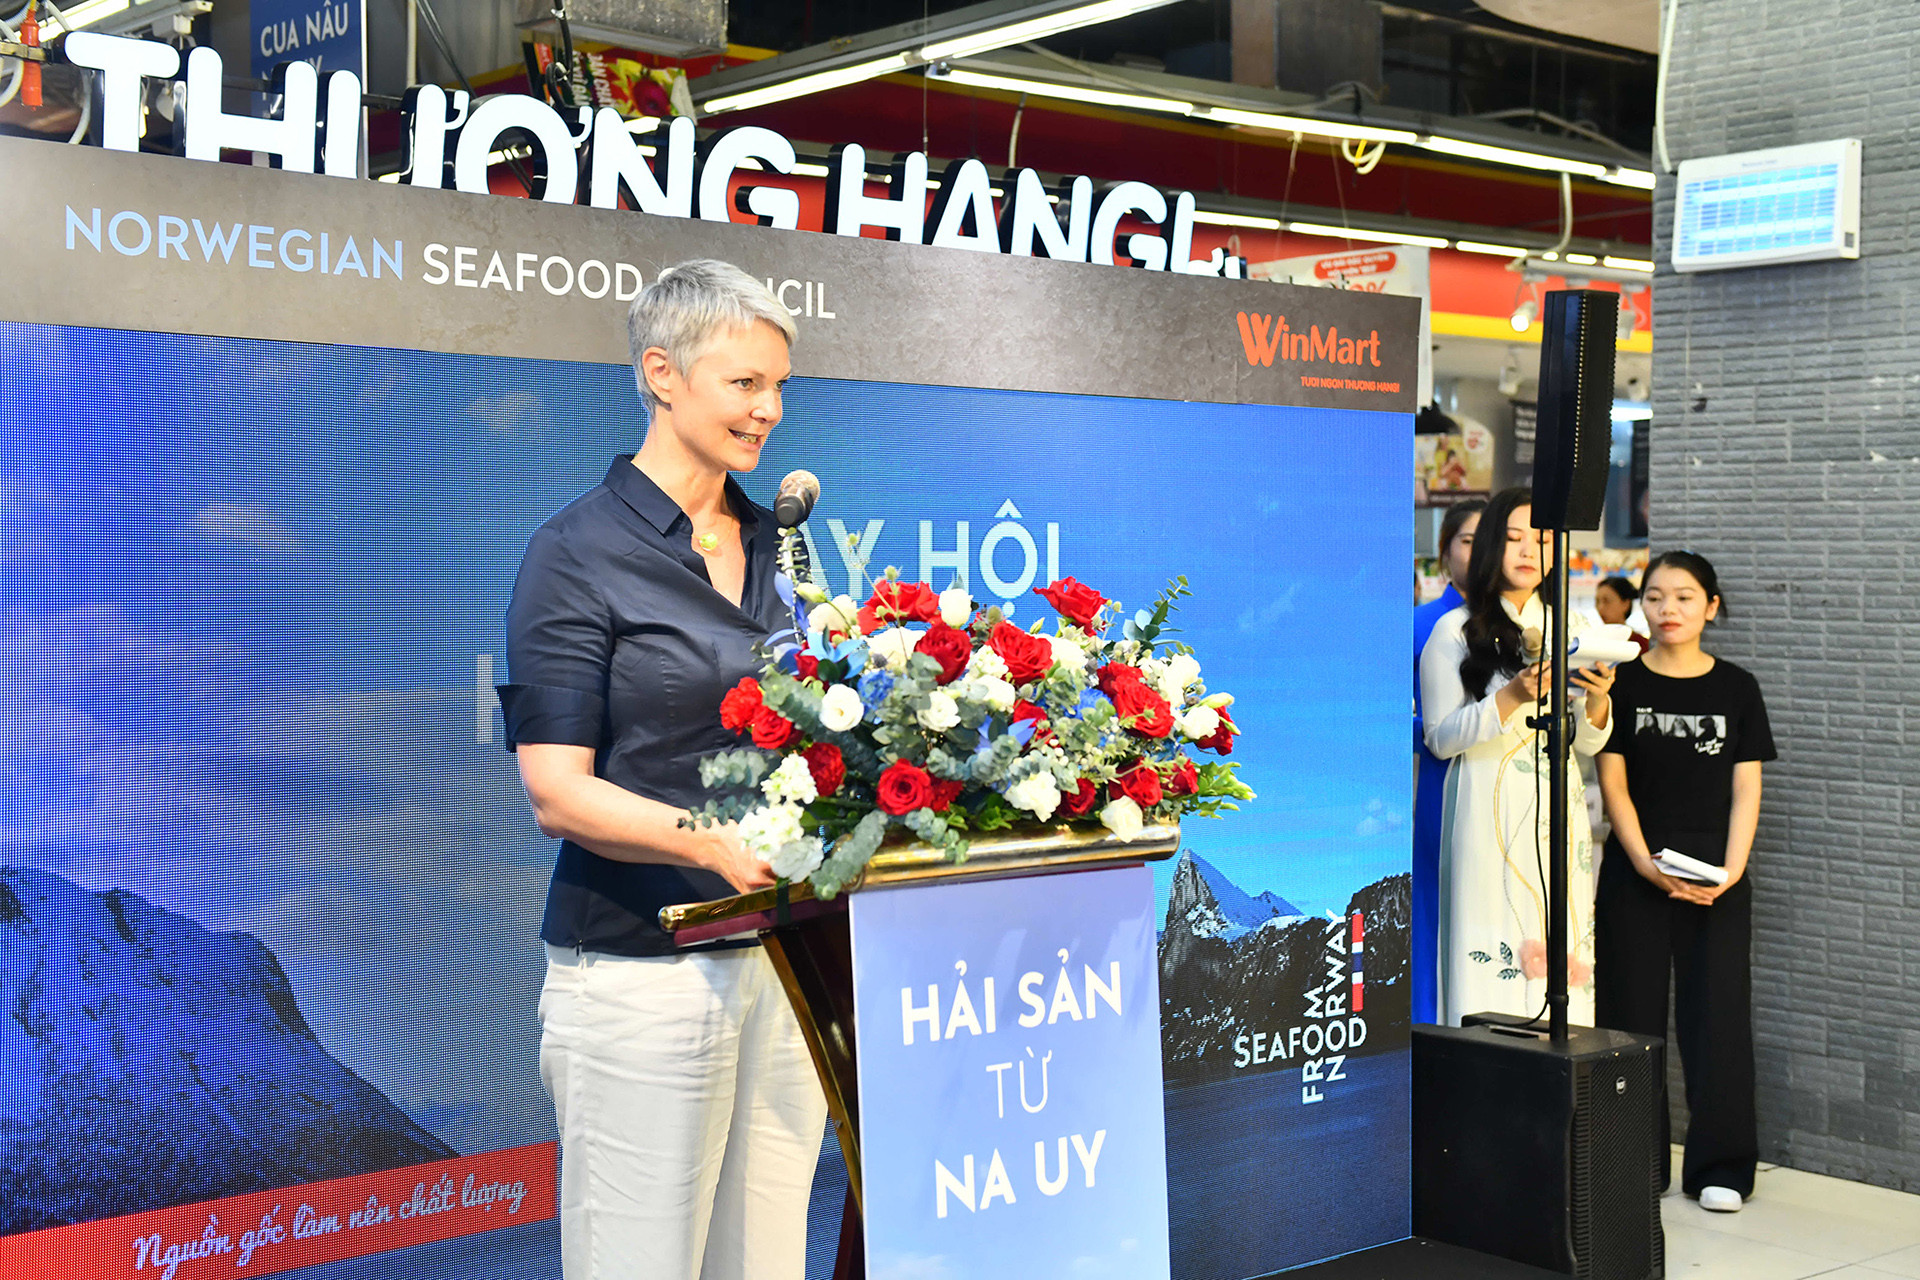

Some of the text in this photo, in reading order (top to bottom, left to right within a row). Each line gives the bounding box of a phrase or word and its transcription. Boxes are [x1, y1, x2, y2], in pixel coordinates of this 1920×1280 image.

[260, 0, 349, 57] CUA NÂU
[64, 204, 404, 281] NORWEGIAN
[421, 243, 643, 302] SEAFOOD
[1236, 311, 1382, 368] WinMart
[1321, 377, 1345, 390] NGON
[918, 498, 1060, 618] HỘI
[901, 948, 1123, 1046] HẢI SẢN
[1233, 1016, 1367, 1068] SEAFOOD
[1324, 908, 1347, 1082] NORWAY
[986, 1046, 1053, 1119] TỪ
[1302, 985, 1325, 1105] FROM
[934, 1130, 1107, 1220] NA UY
[133, 1172, 529, 1280] Nguồn gốc làm nên chất lượng
